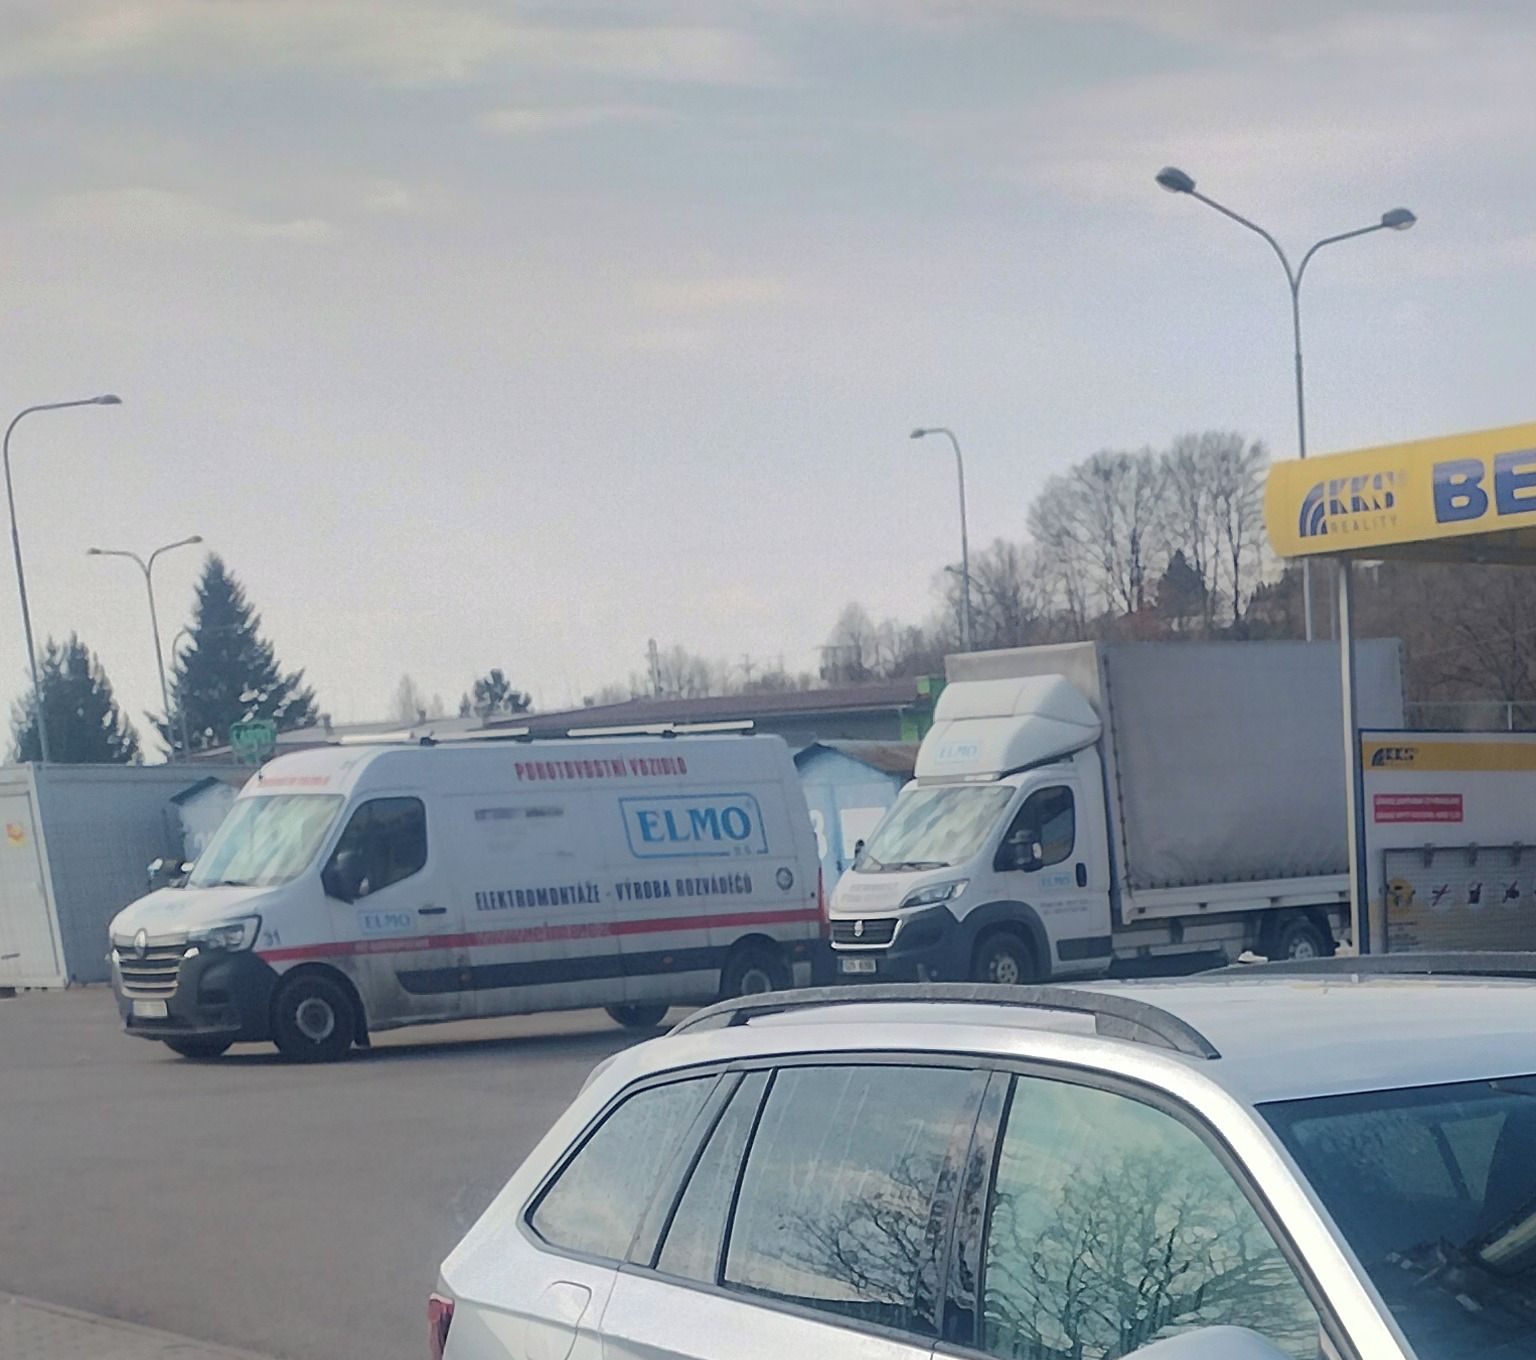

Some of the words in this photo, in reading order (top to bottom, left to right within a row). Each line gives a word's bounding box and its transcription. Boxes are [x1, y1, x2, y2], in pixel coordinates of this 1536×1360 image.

[1329, 514, 1398, 534] REALITY
[629, 756, 688, 776] VOZIDLO
[635, 806, 752, 843] ELMO
[474, 881, 600, 911] ELEKTROMONTÁŽE
[615, 877, 671, 901] VÝROBA
[364, 913, 410, 930] ELMO
